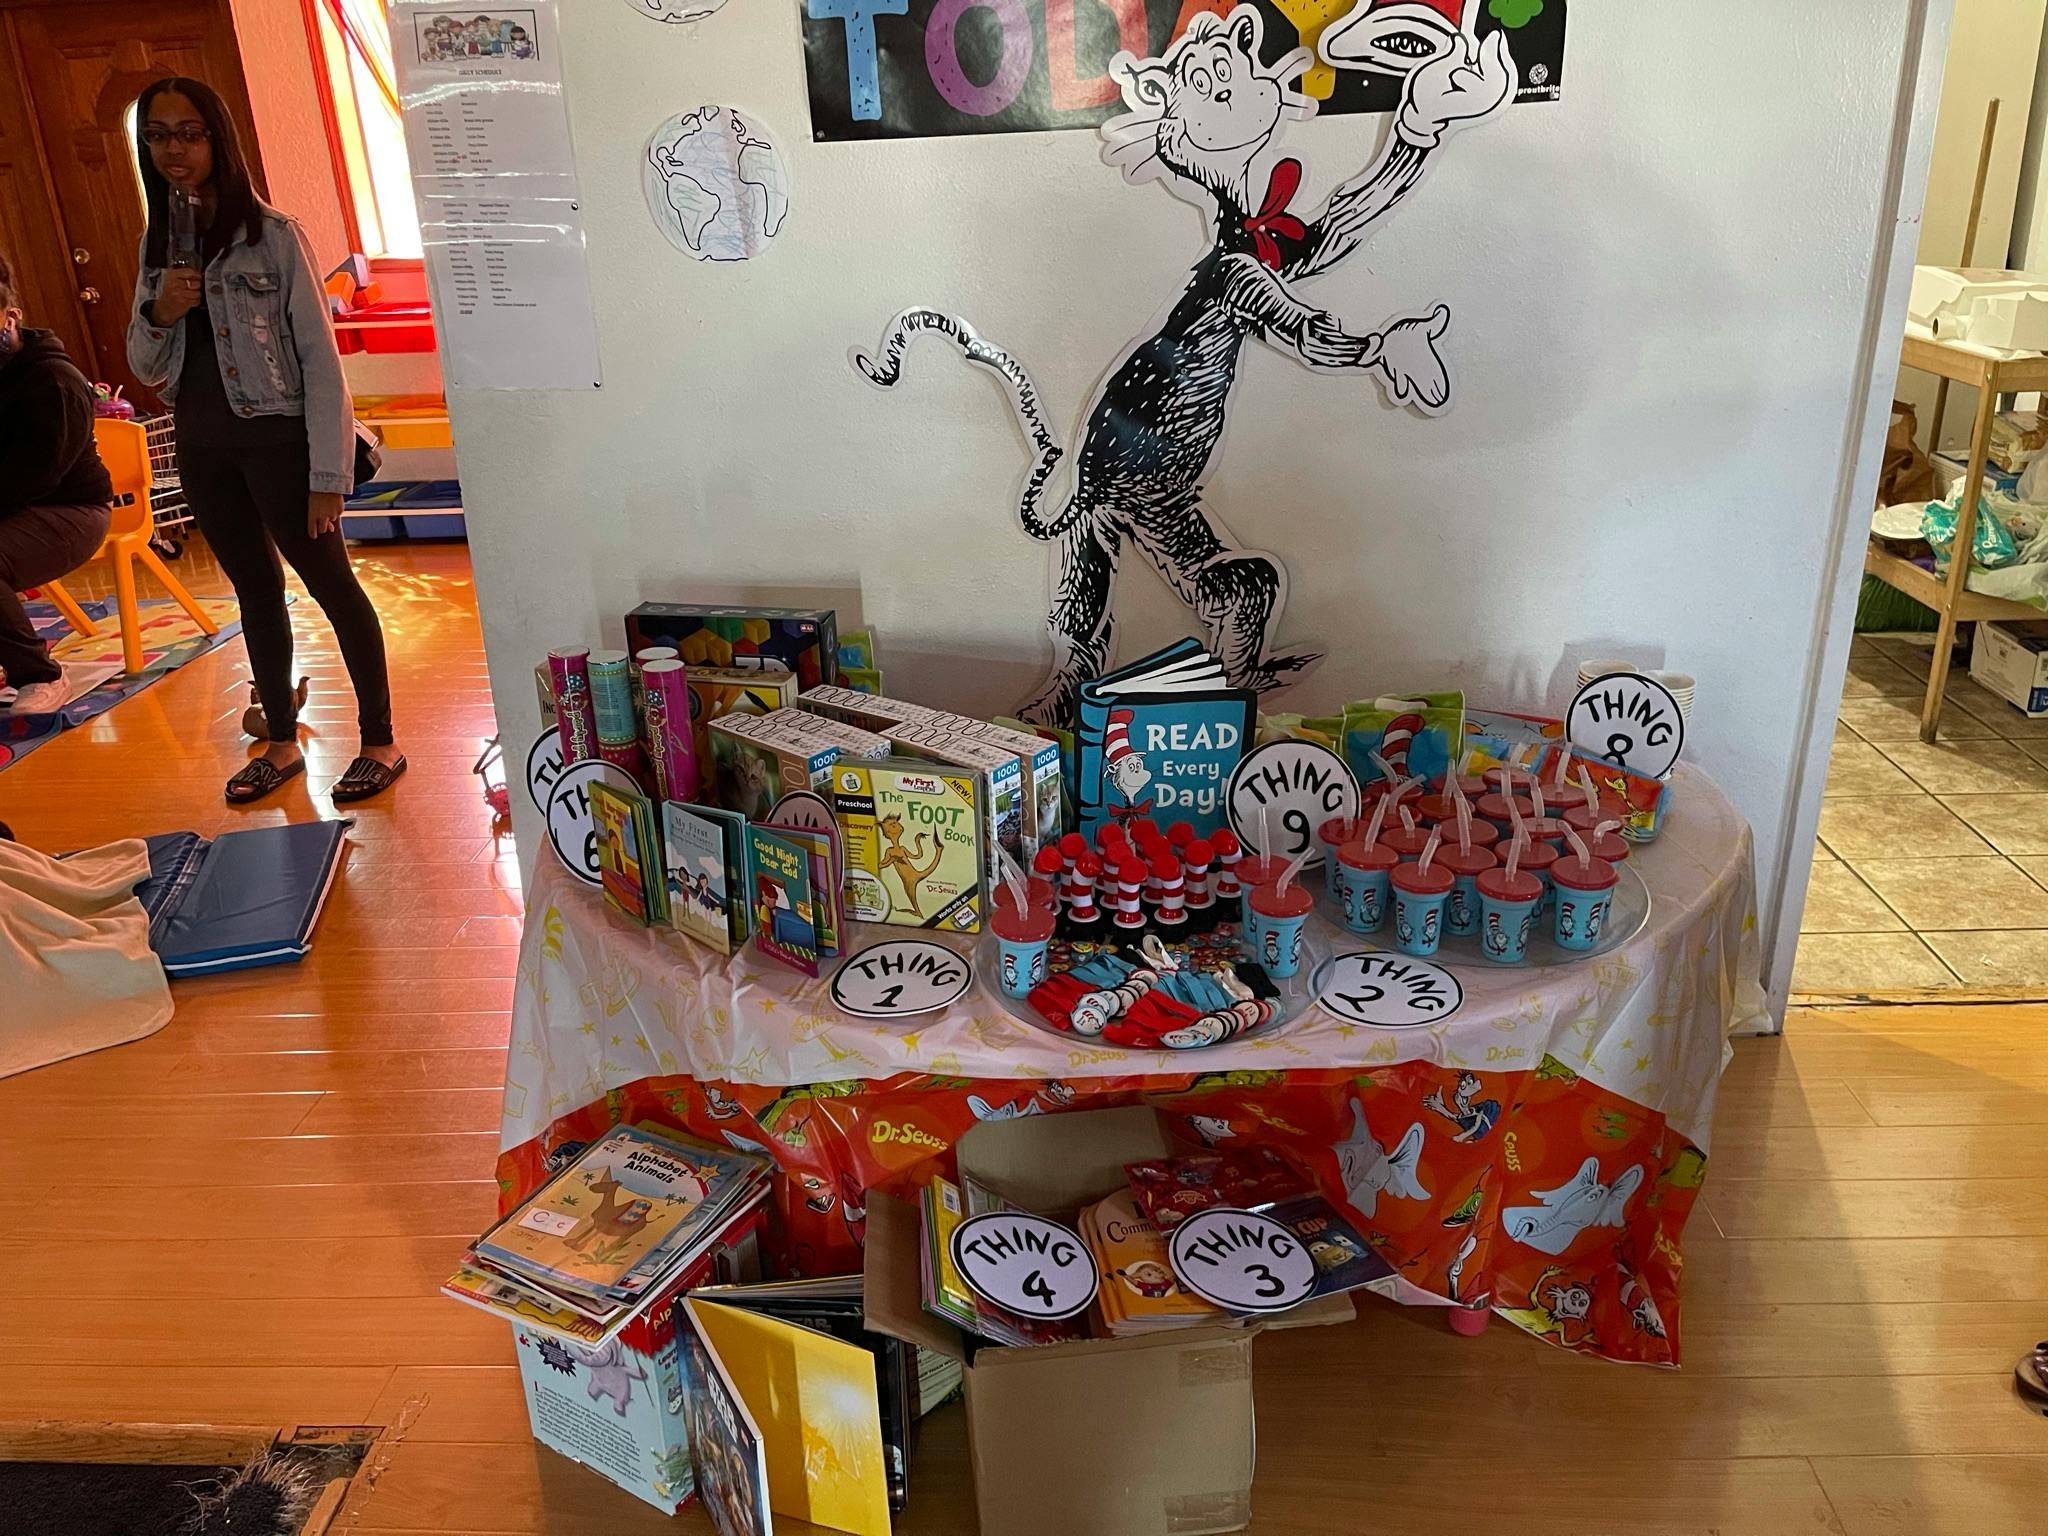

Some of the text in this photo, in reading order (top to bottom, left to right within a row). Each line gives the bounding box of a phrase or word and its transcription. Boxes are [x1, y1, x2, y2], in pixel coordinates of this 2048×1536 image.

[1518, 84, 1560, 96] proutbrite
[806, 686, 868, 708] 1000
[716, 713, 777, 737] 1000
[770, 708, 827, 732] 1000
[926, 711, 989, 736] 1000
[1579, 689, 1673, 747] THING
[889, 722, 952, 748] 1000
[1146, 723, 1239, 751] READ
[813, 752, 838, 769] 1000
[1037, 749, 1057, 766] 1000
[1602, 733, 1634, 767] 8
[902, 777, 935, 787] My First
[996, 762, 1018, 780] 1000
[1162, 760, 1220, 779] Every
[879, 791, 904, 803] The
[951, 780, 972, 801] NEW!
[1155, 778, 1228, 814] Day!
[1239, 758, 1344, 813] THING
[837, 800, 873, 809] Preschool
[907, 801, 965, 827] FOOT
[1282, 809, 1311, 855] 9
[754, 837, 774, 856] Good
[760, 852, 798, 880] Dear God
[850, 952, 961, 986] THING
[872, 984, 904, 1007] 1
[1354, 956, 1447, 1011] THING
[1334, 985, 1385, 1013] 2
[624, 1160, 675, 1184] Animals
[627, 1151, 689, 1178] Alphabet
[533, 1211, 550, 1223] C
[963, 1226, 1078, 1267] THING
[1184, 1224, 1295, 1267] THING
[1021, 1269, 1057, 1307] 4
[1244, 1264, 1285, 1298] 3
